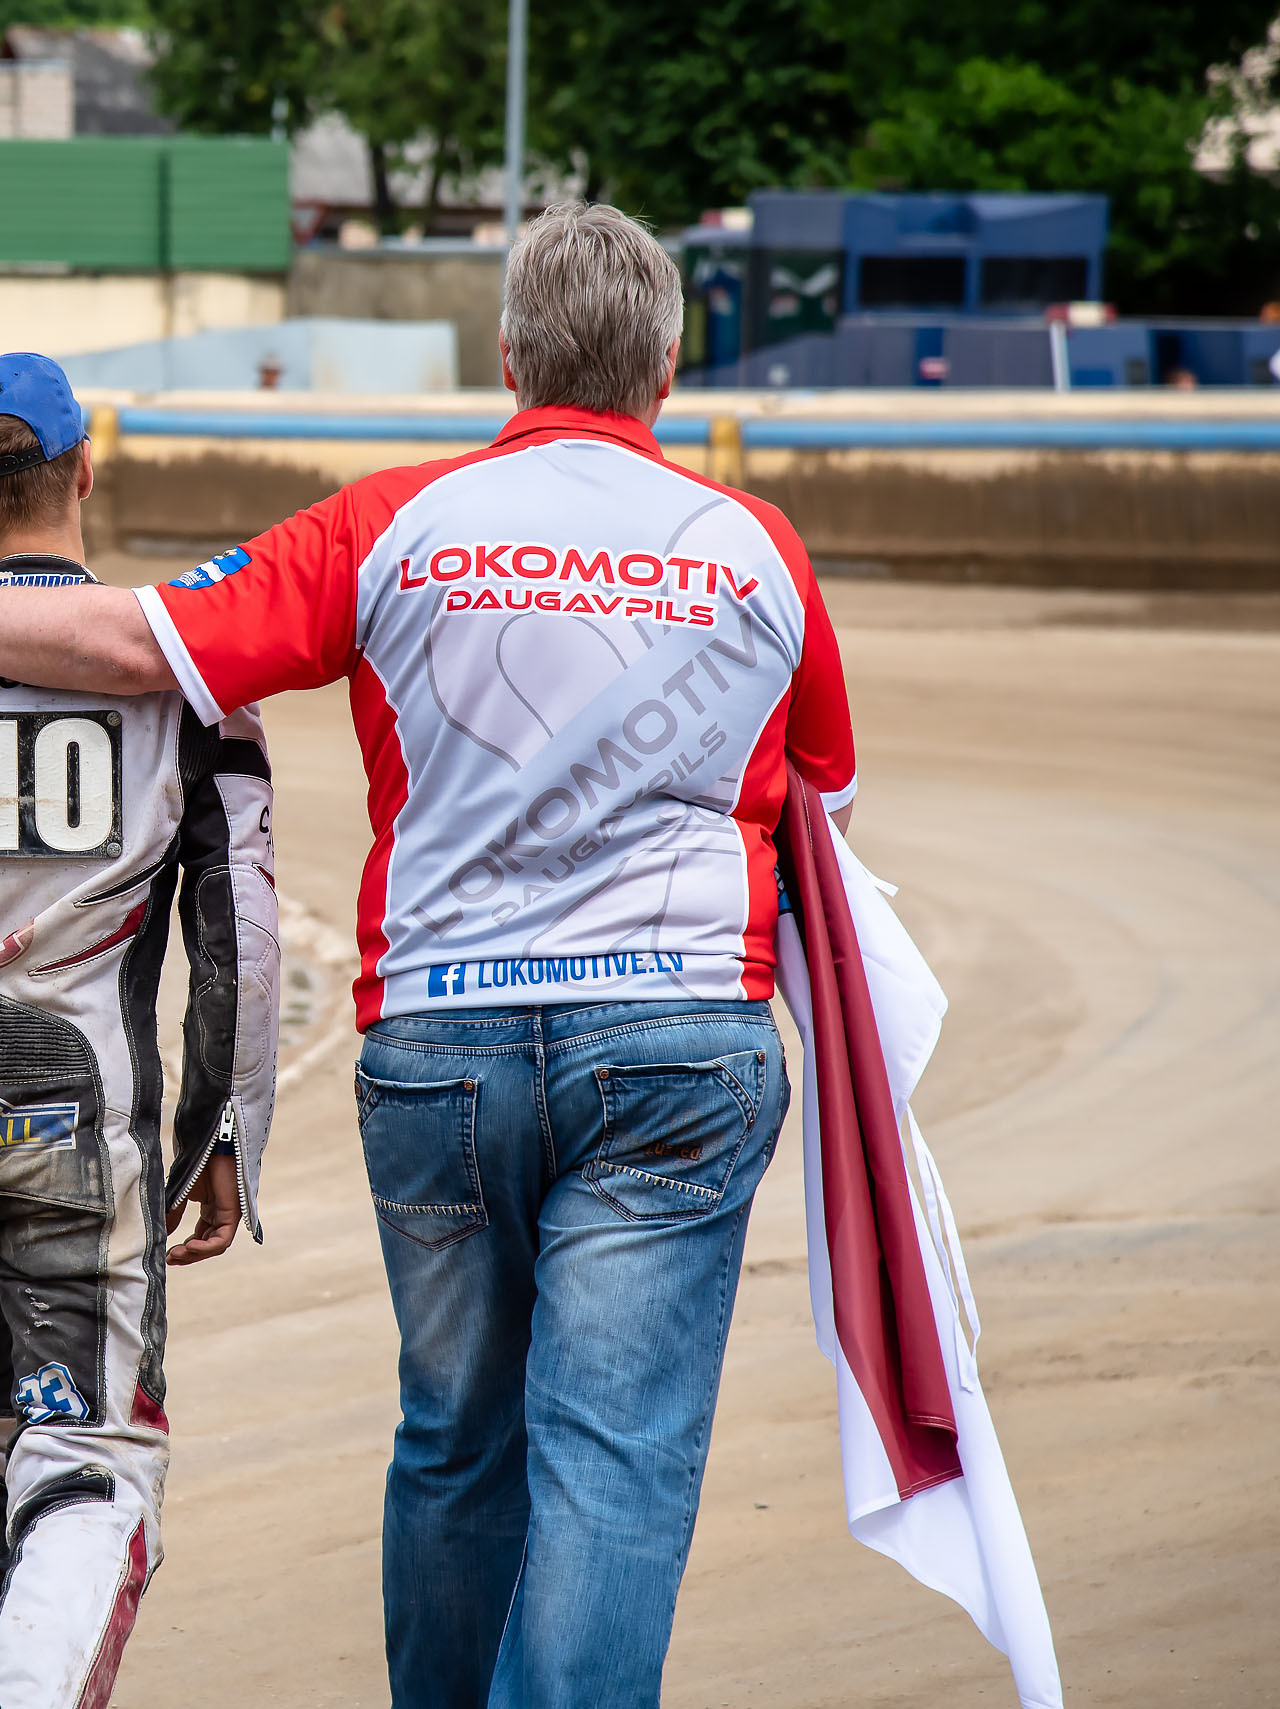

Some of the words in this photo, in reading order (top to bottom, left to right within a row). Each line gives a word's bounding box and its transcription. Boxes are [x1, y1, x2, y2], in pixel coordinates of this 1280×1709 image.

[399, 544, 761, 602] LOKOMOTIV
[445, 588, 715, 627] DAUGAVPILS
[410, 611, 759, 940] LOKOMOTIV
[490, 721, 728, 928] DAUGAVPILS
[477, 952, 685, 989] LOKOMOTIVE.LV
